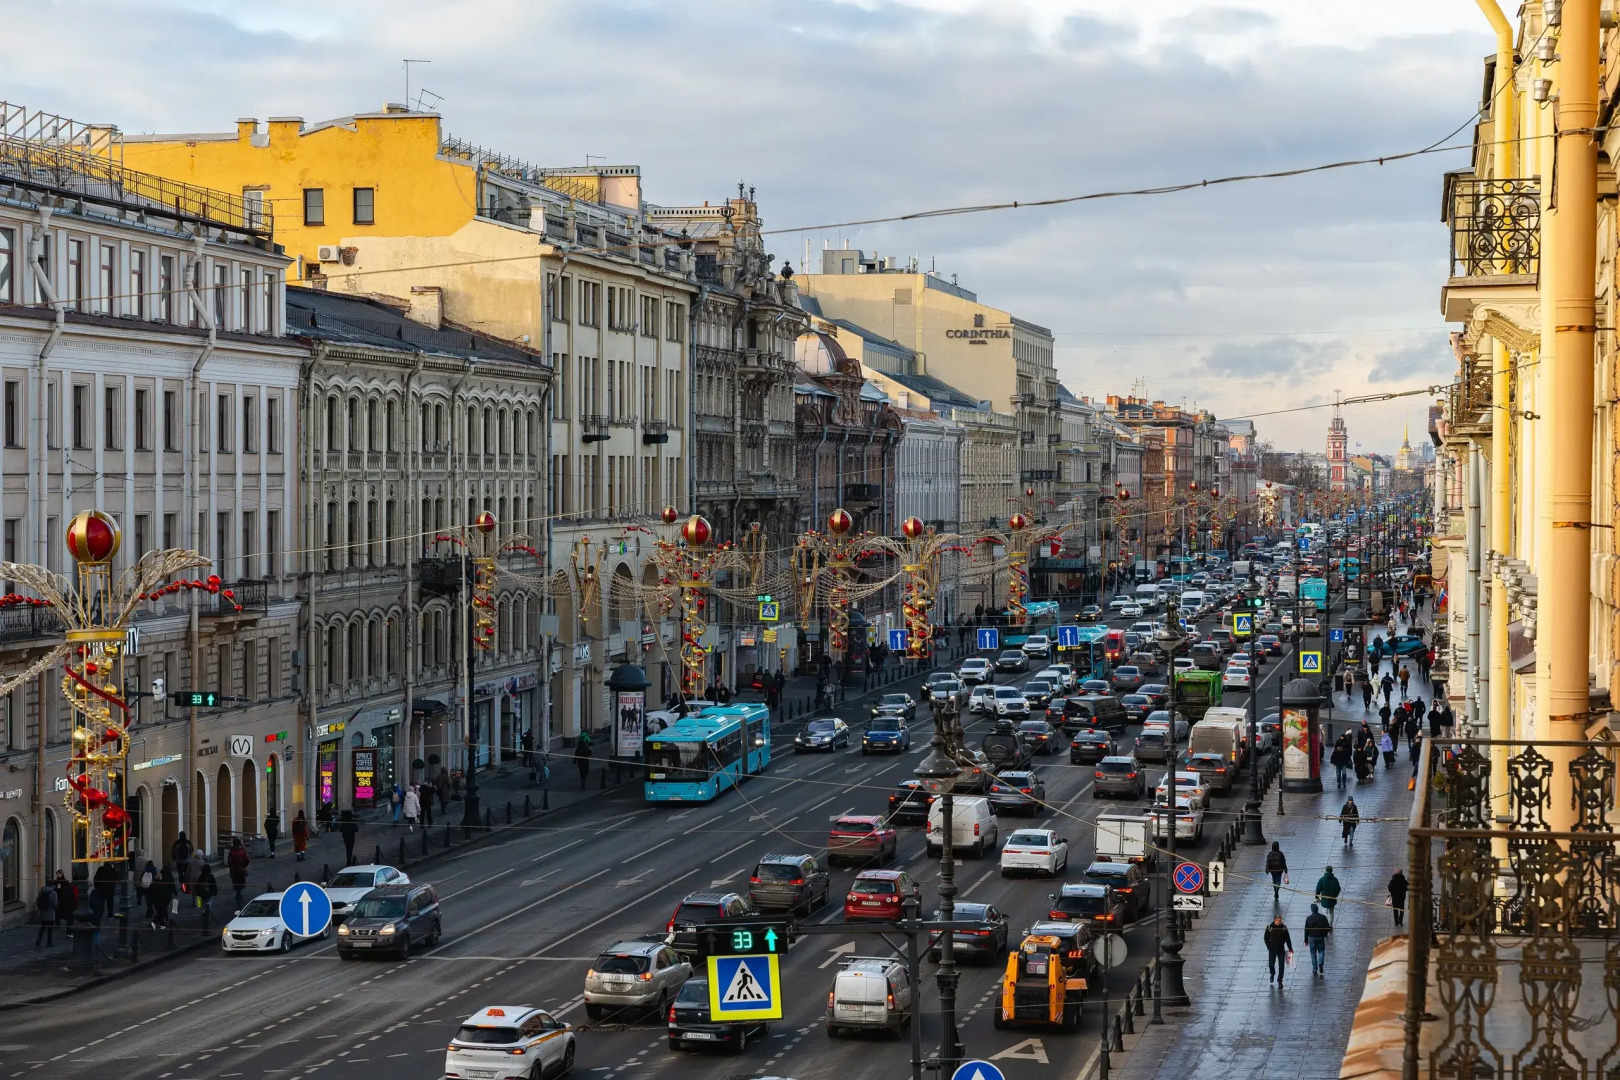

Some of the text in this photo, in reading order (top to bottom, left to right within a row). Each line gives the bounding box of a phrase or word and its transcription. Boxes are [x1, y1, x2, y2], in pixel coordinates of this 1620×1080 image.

[945, 329, 1010, 339] CORINTHIA
[192, 694, 202, 704] 33
[733, 930, 752, 949] 33
